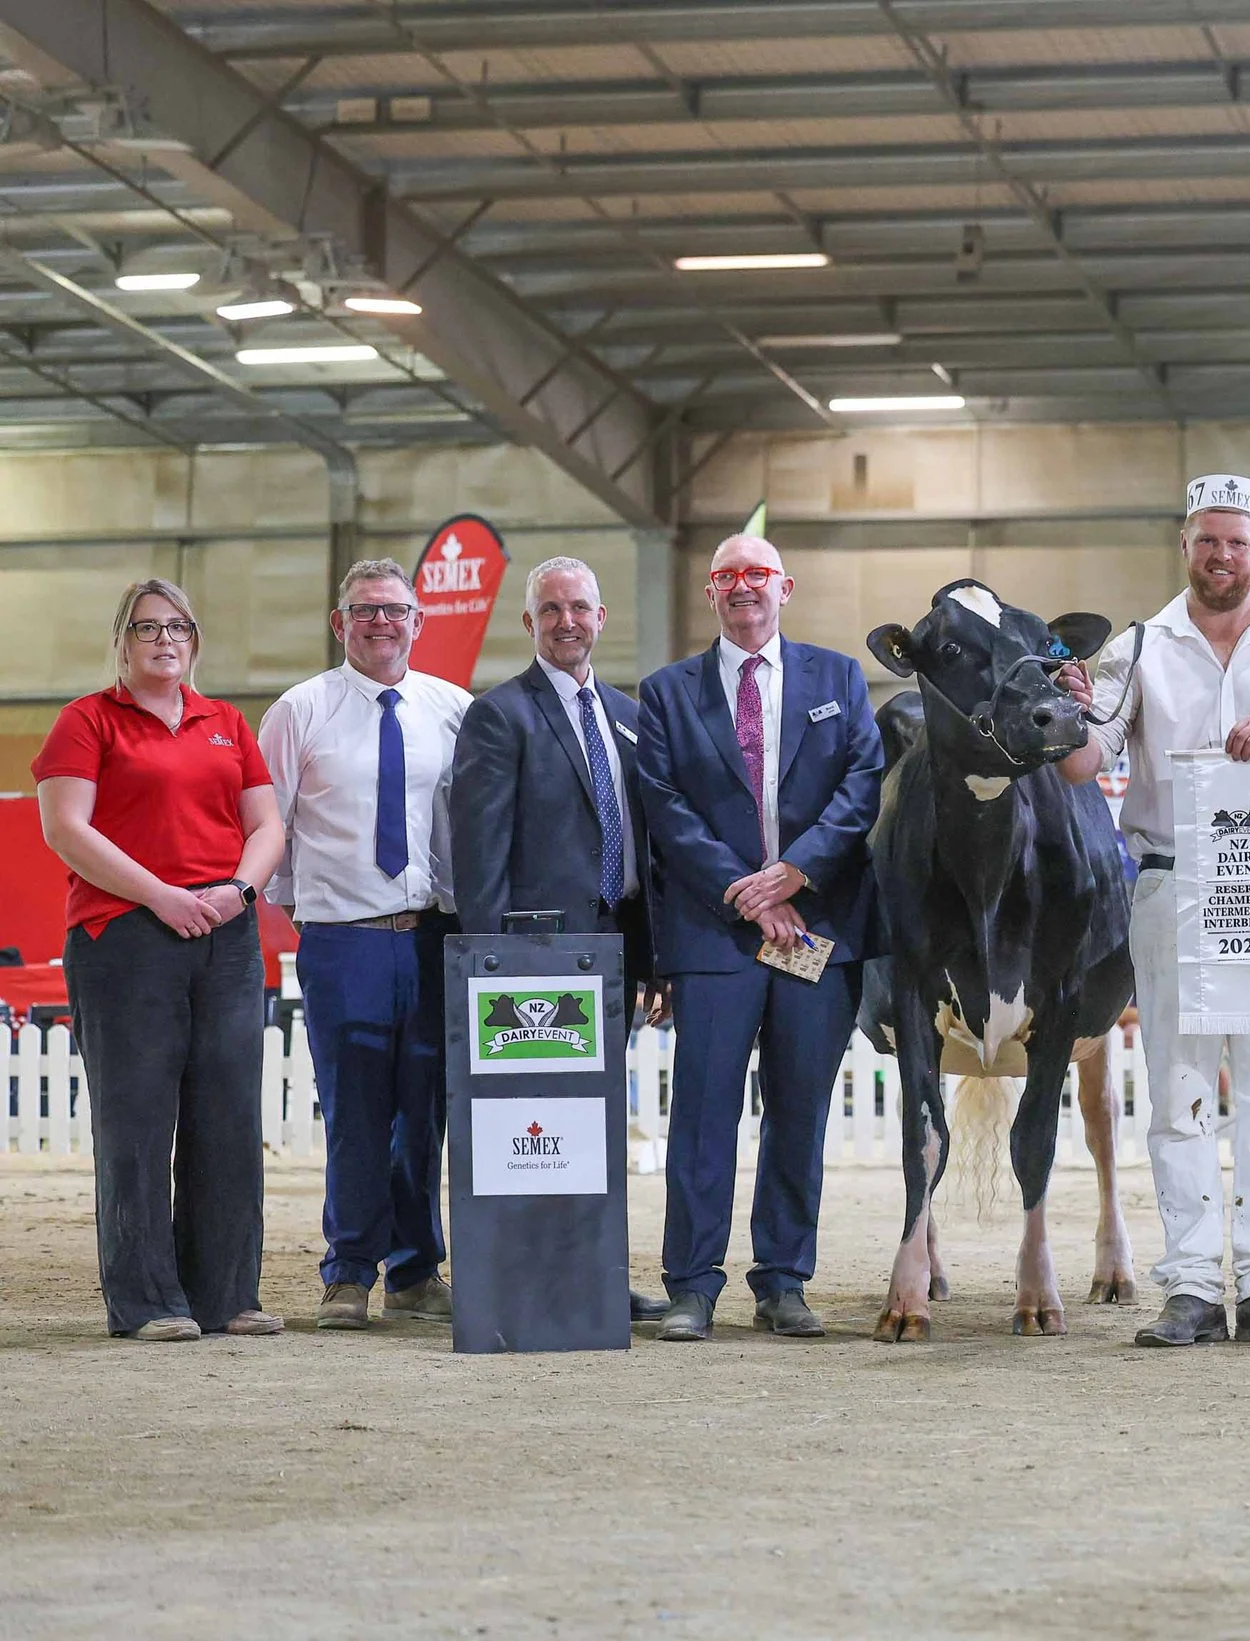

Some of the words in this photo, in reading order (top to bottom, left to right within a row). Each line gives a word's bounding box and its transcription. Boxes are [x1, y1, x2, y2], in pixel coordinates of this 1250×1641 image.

[1211, 490, 1250, 508] SEMEX
[422, 557, 486, 593] SEMEX
[1230, 838, 1249, 850] NZ
[529, 1003, 545, 1013] NZ
[501, 1029, 574, 1042] DAIRYEVENT
[512, 1136, 561, 1155] SEMEX
[507, 1161, 539, 1170] Genetics
[540, 1160, 552, 1169] for
